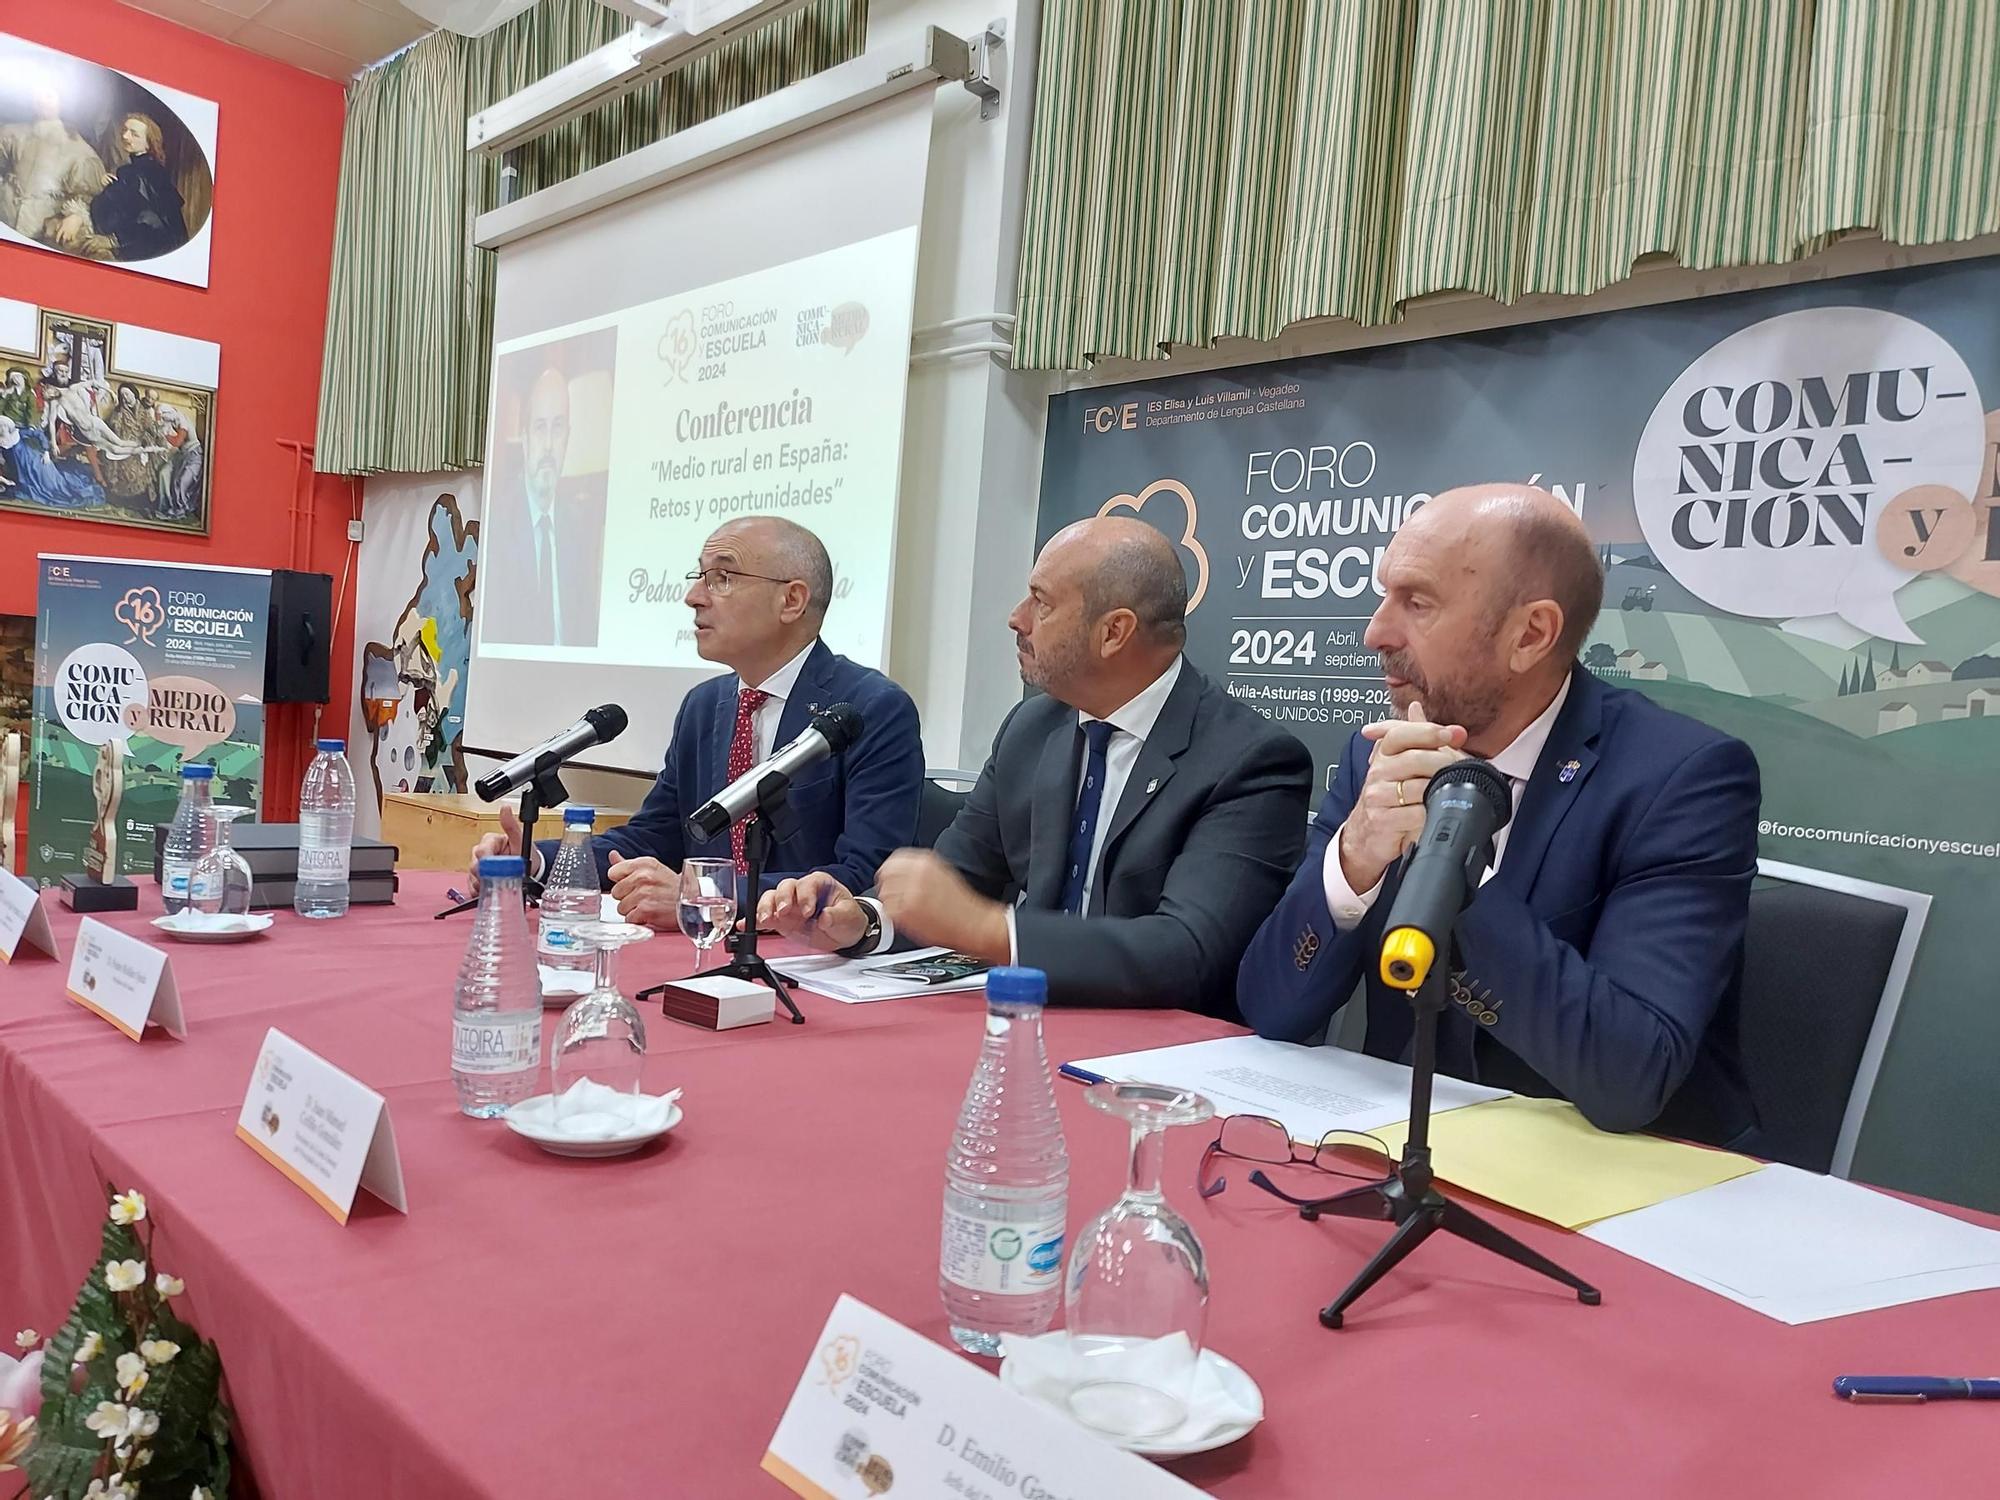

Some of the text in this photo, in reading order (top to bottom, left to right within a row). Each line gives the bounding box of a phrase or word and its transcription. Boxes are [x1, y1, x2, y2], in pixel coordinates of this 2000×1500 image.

[701, 306, 779, 340] COMUNICACIÓN
[702, 300, 735, 322] FORO
[706, 330, 767, 360] ESCUELA
[698, 362, 727, 382] 2024
[1146, 383, 1301, 414] IES Elisa y Luis Villamil Vegadeo
[1682, 365, 1967, 439] COMU-
[676, 387, 813, 443] Conferencia
[1083, 401, 1139, 435] FCyE
[1146, 398, 1306, 430] Departamento de Lengua Castellana
[711, 447, 748, 477] rural
[752, 452, 773, 472] en
[779, 437, 849, 474] España:
[1246, 440, 1377, 496] FORO
[1673, 433, 1913, 496] NICA-
[649, 496, 690, 520] Retos
[694, 498, 705, 523] y
[1670, 492, 1876, 551] CIÓN
[1903, 508, 1949, 558] y
[628, 565, 684, 604] Pedro
[1235, 554, 1256, 590] y
[130, 597, 155, 624] 16
[168, 590, 206, 607] FORO
[167, 605, 254, 623] COMUNICACIÓN
[174, 618, 245, 638] ESCUELA
[165, 638, 192, 651] 2024
[1228, 629, 1359, 666] 2024 Abril,
[67, 663, 145, 687] COMU-
[66, 682, 131, 705] NICA-
[150, 688, 227, 715] MEDIO
[1226, 680, 1317, 702] Ávila-Asturias
[65, 701, 120, 725] CIÓN
[130, 710, 142, 727] y
[149, 708, 227, 734] RURAL
[1275, 705, 1330, 723] UNIDOS
[1332, 709, 1365, 726] POR
[936, 1422, 957, 1452] D.
[959, 1436, 1018, 1488] Emilio
